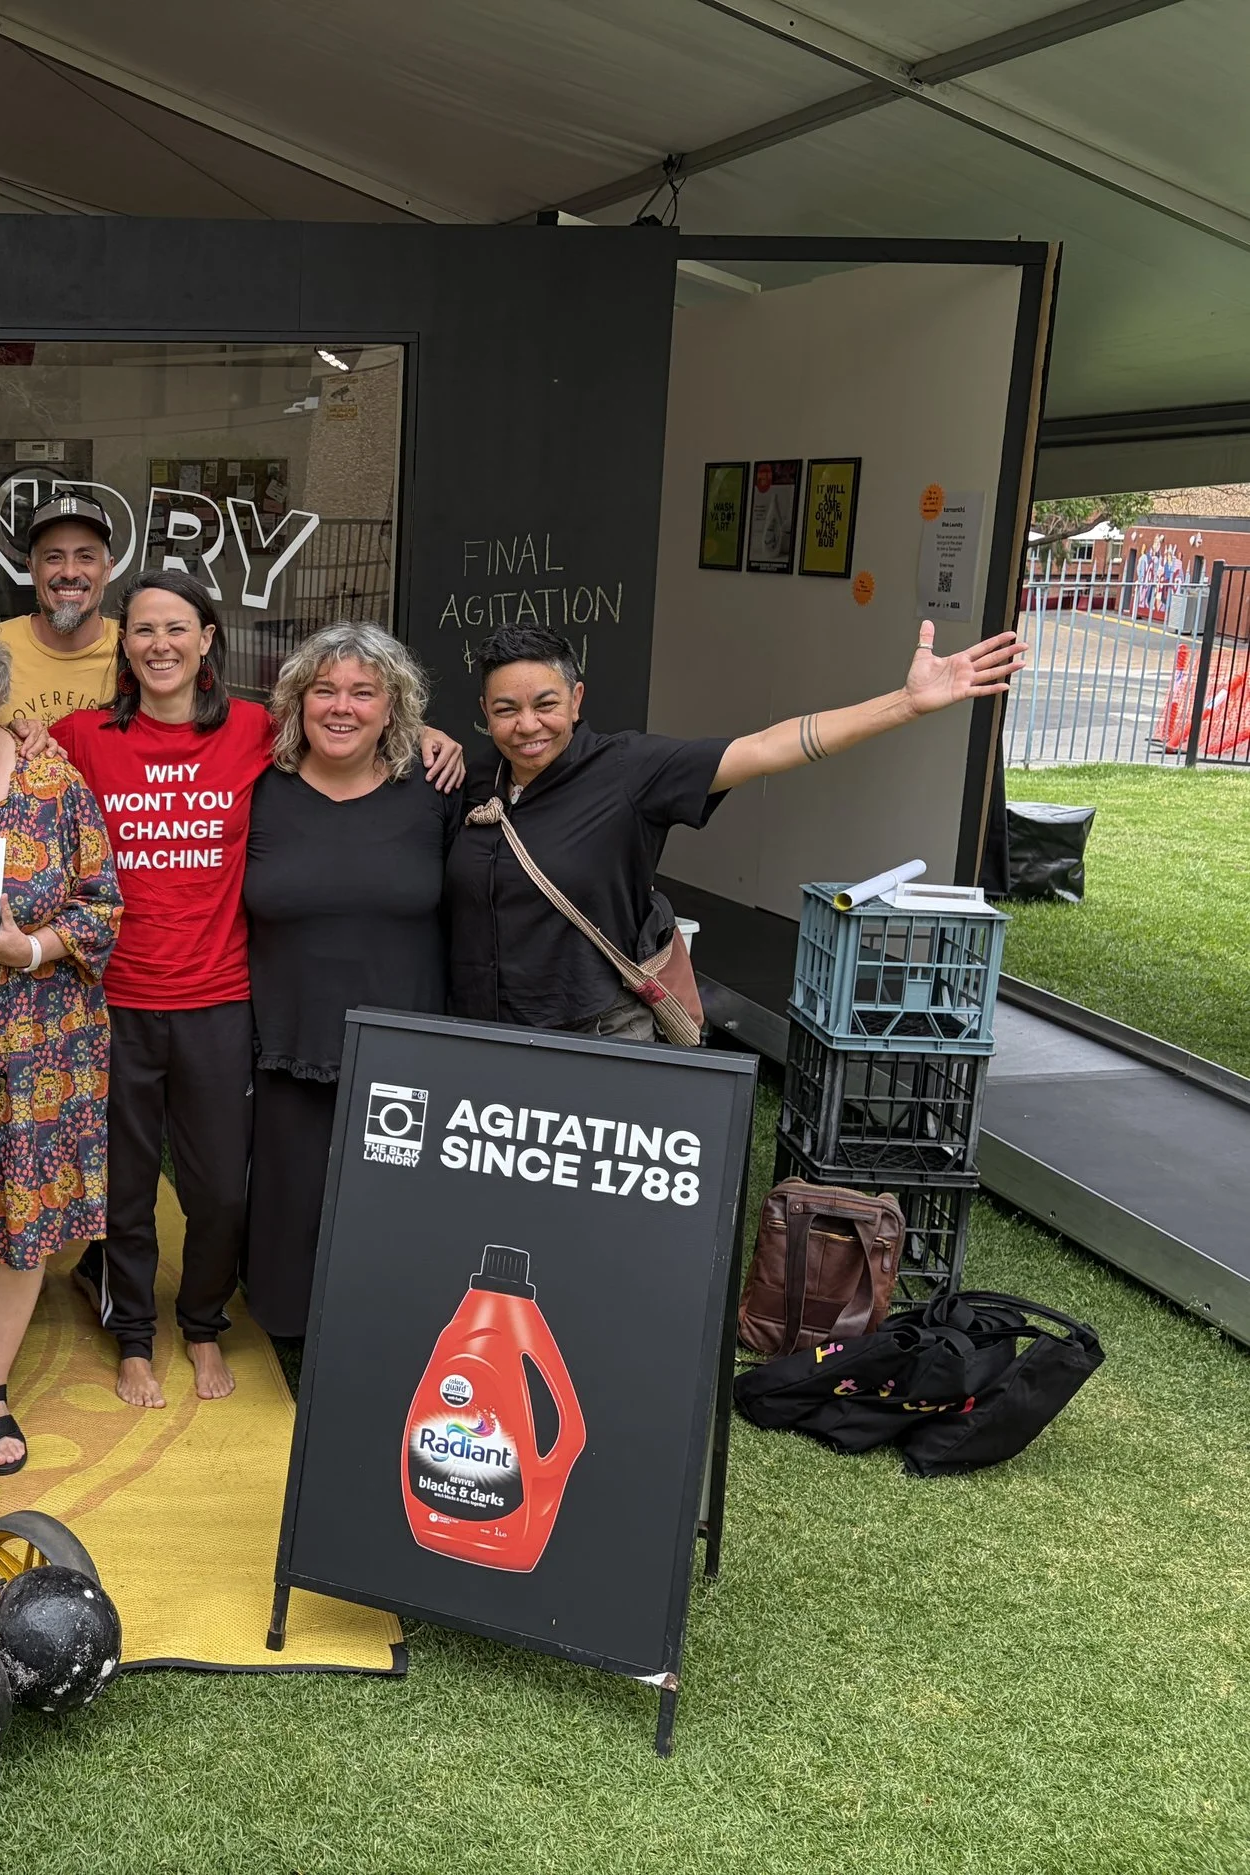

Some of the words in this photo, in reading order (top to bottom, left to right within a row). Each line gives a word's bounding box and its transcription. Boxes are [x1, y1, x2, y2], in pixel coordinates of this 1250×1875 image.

[827, 483, 845, 494] WILL
[713, 502, 735, 512] WASH
[815, 511, 831, 521] OUT
[833, 511, 843, 521] IN
[818, 502, 841, 512] COME
[715, 521, 730, 532] ART
[821, 520, 835, 529] THE
[815, 529, 838, 539] WASH
[463, 532, 564, 577] FINAL
[438, 581, 623, 630] AGITATION
[144, 763, 201, 784] WHY
[103, 792, 177, 813] WONT
[182, 791, 234, 811] YOU
[118, 820, 225, 841] CHANGE
[117, 848, 223, 870] MACHINE
[445, 1099, 702, 1167] AGITATING
[364, 1141, 387, 1153] THE
[389, 1146, 420, 1159] BLAK
[363, 1151, 419, 1168] LAUNDRY
[439, 1135, 581, 1188] SINCE
[591, 1159, 700, 1207] 1788
[445, 1383, 467, 1393] guard
[419, 1427, 512, 1469] Radiant
[449, 1475, 476, 1488] REVIVES
[418, 1475, 457, 1496] blacks
[458, 1486, 469, 1498] &
[470, 1488, 505, 1507] darks
